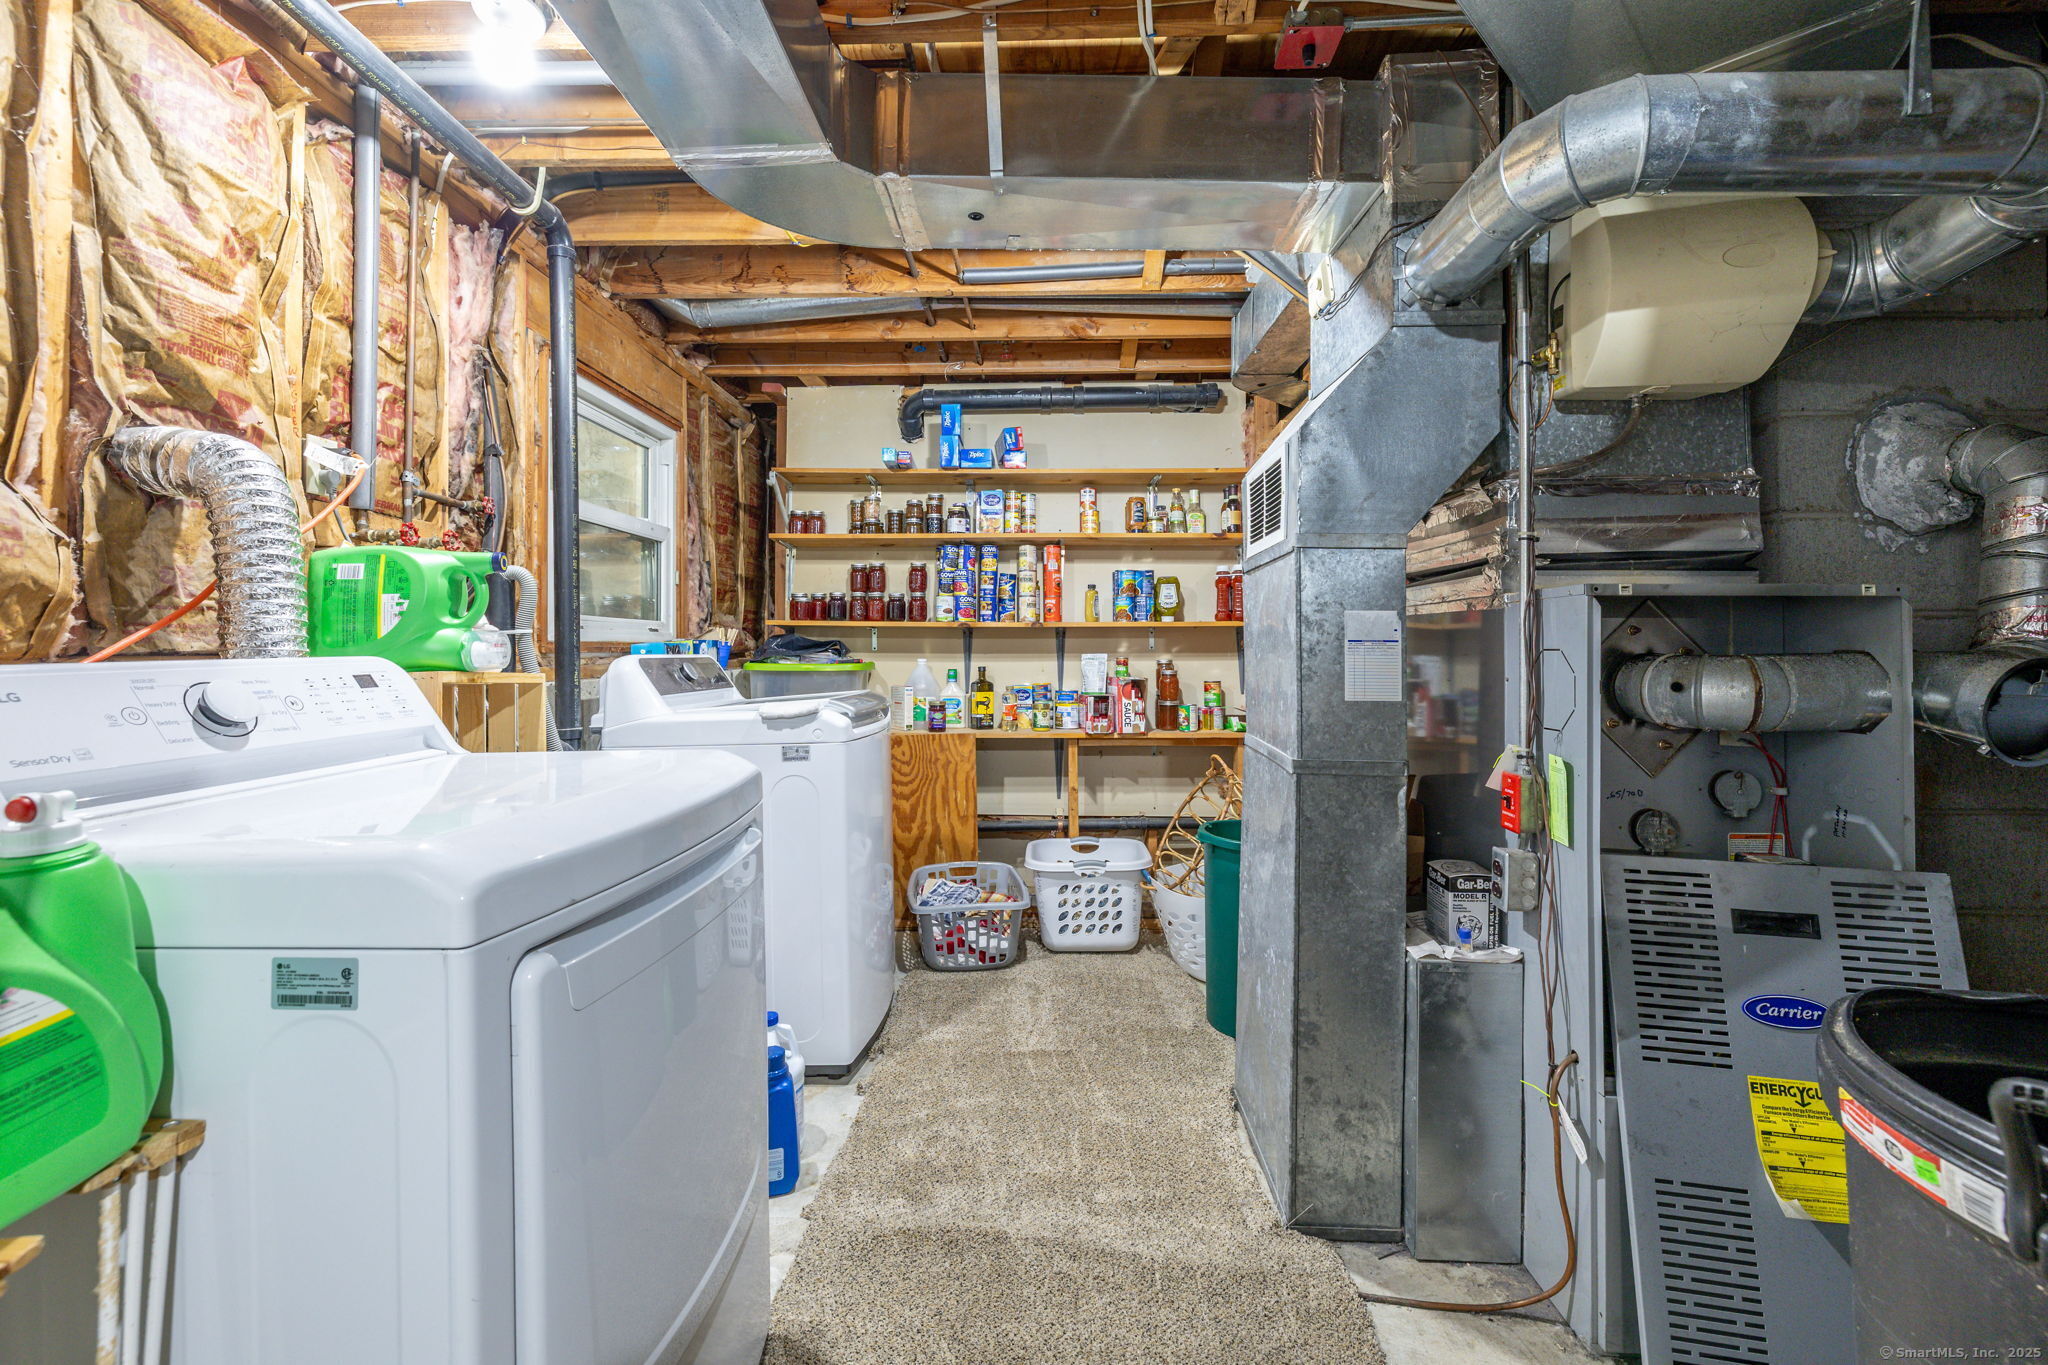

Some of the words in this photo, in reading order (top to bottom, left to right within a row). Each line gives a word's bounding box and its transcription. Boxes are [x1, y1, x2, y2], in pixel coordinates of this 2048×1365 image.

[944, 411, 952, 428] Ziploc
[969, 451, 986, 459] Ziploc
[1124, 701, 1132, 728] SAUCE
[1755, 1002, 1823, 1020] Carrier
